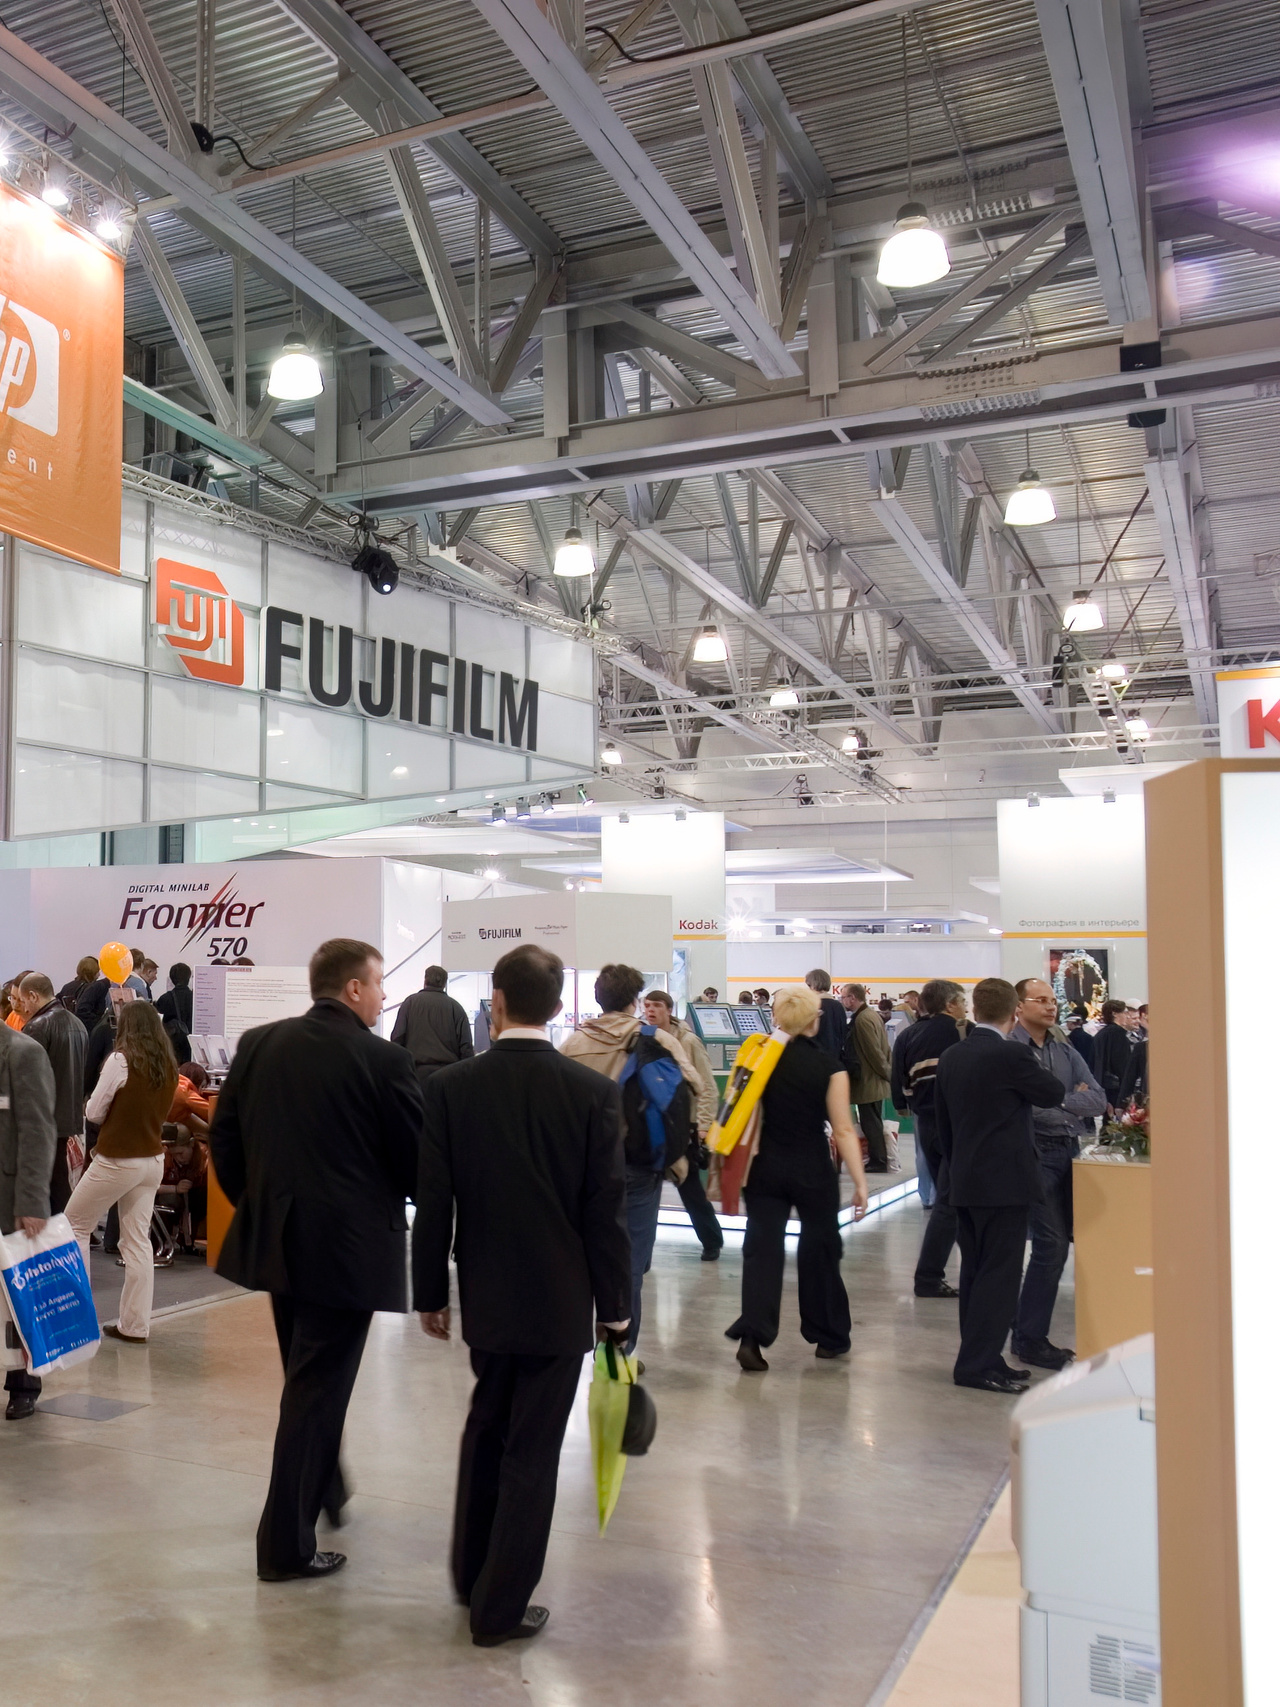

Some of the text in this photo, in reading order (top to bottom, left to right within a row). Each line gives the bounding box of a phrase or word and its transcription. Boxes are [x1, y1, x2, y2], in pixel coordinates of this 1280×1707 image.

[265, 606, 540, 752] FUJIFILM
[128, 883, 210, 893] DIGITAL MINILAB
[119, 897, 265, 930] Frontier
[679, 919, 719, 930] Kodak
[488, 928, 521, 939] FUJIFILM
[207, 937, 248, 957] 570
